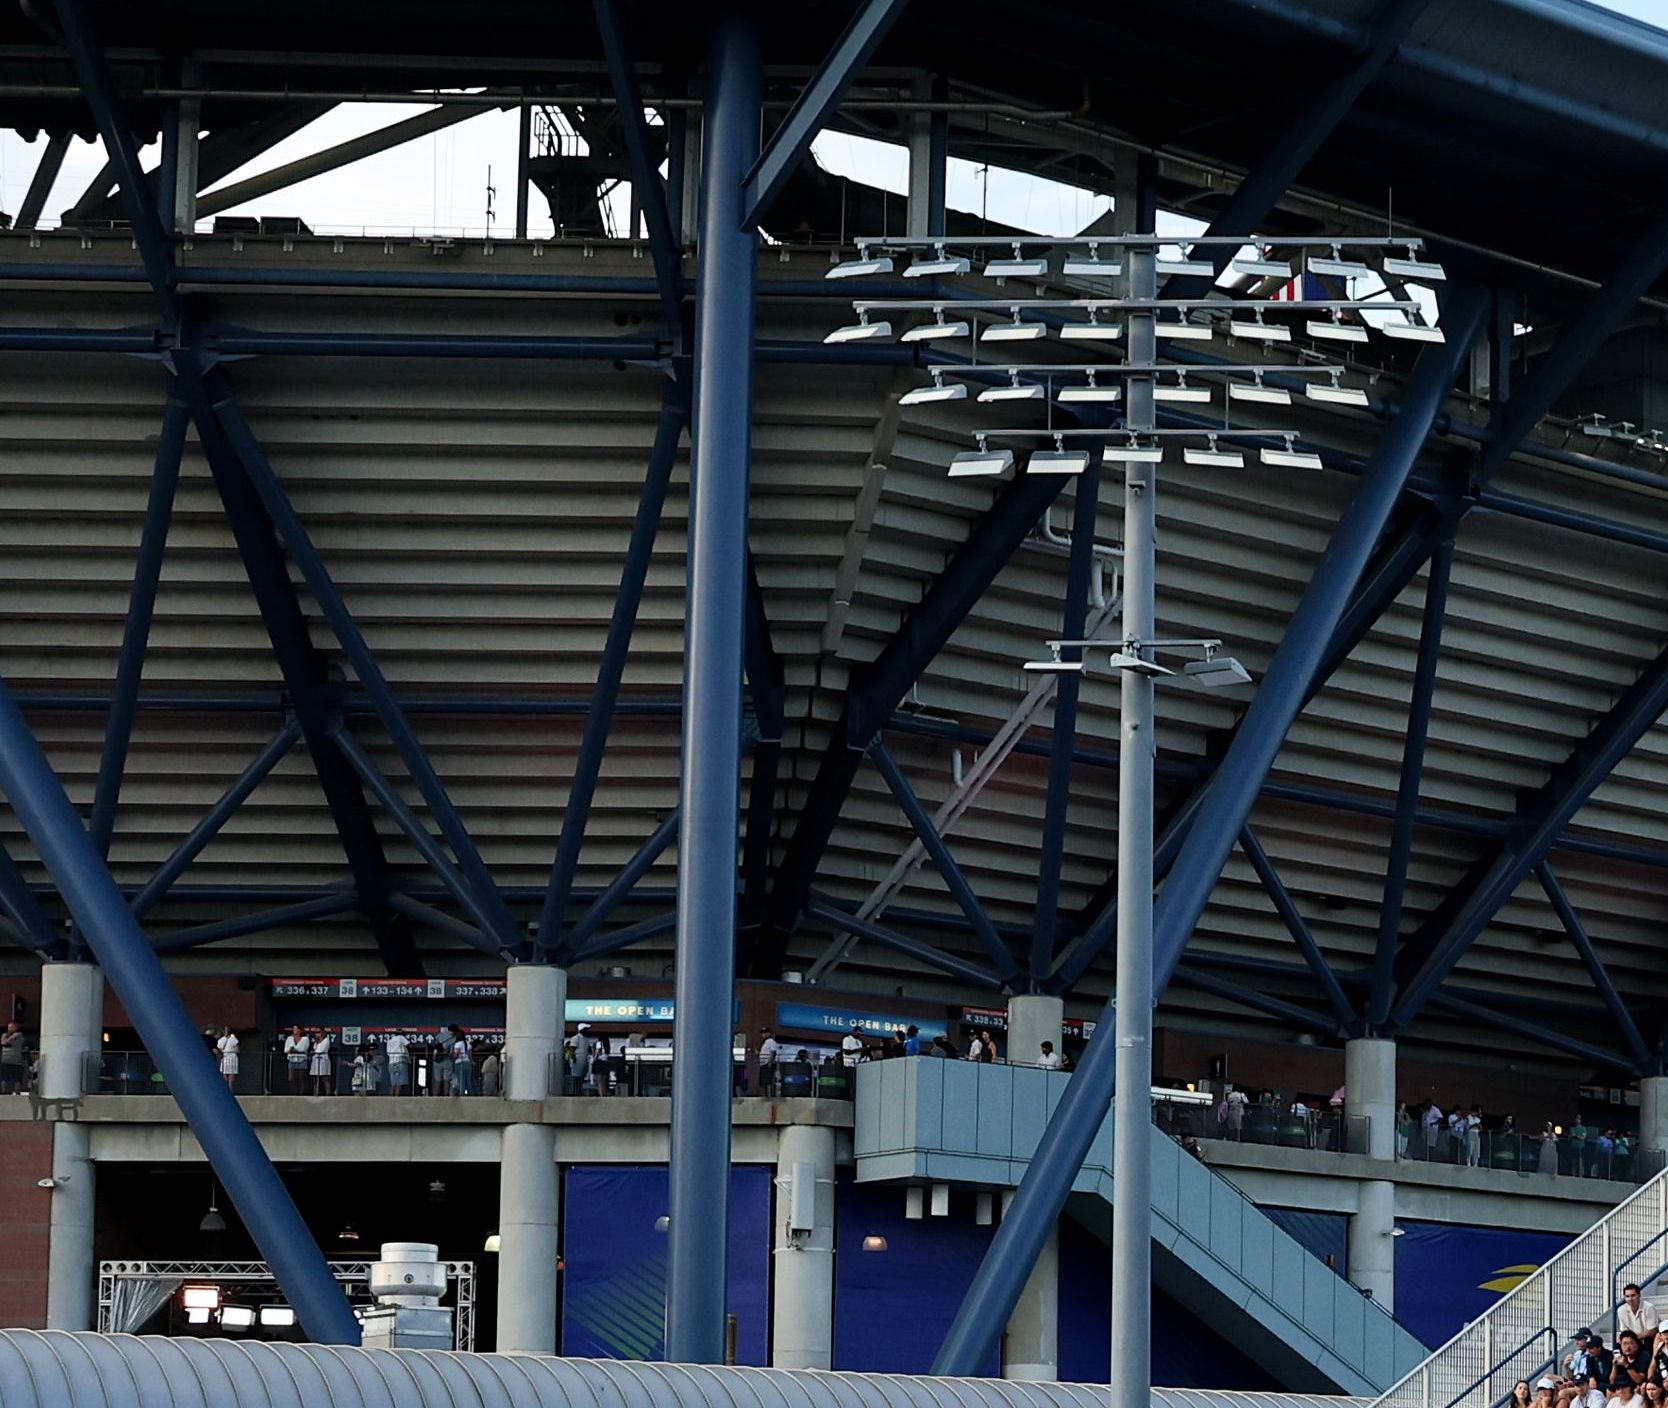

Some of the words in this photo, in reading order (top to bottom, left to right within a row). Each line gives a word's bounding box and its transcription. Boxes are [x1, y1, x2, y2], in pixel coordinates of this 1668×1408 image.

[586, 1006, 611, 1016] THE
[617, 1006, 654, 1016] OPEN
[823, 1015, 844, 1026] THE
[850, 1018, 880, 1029] OPEN
[884, 1021, 908, 1034] BAR
